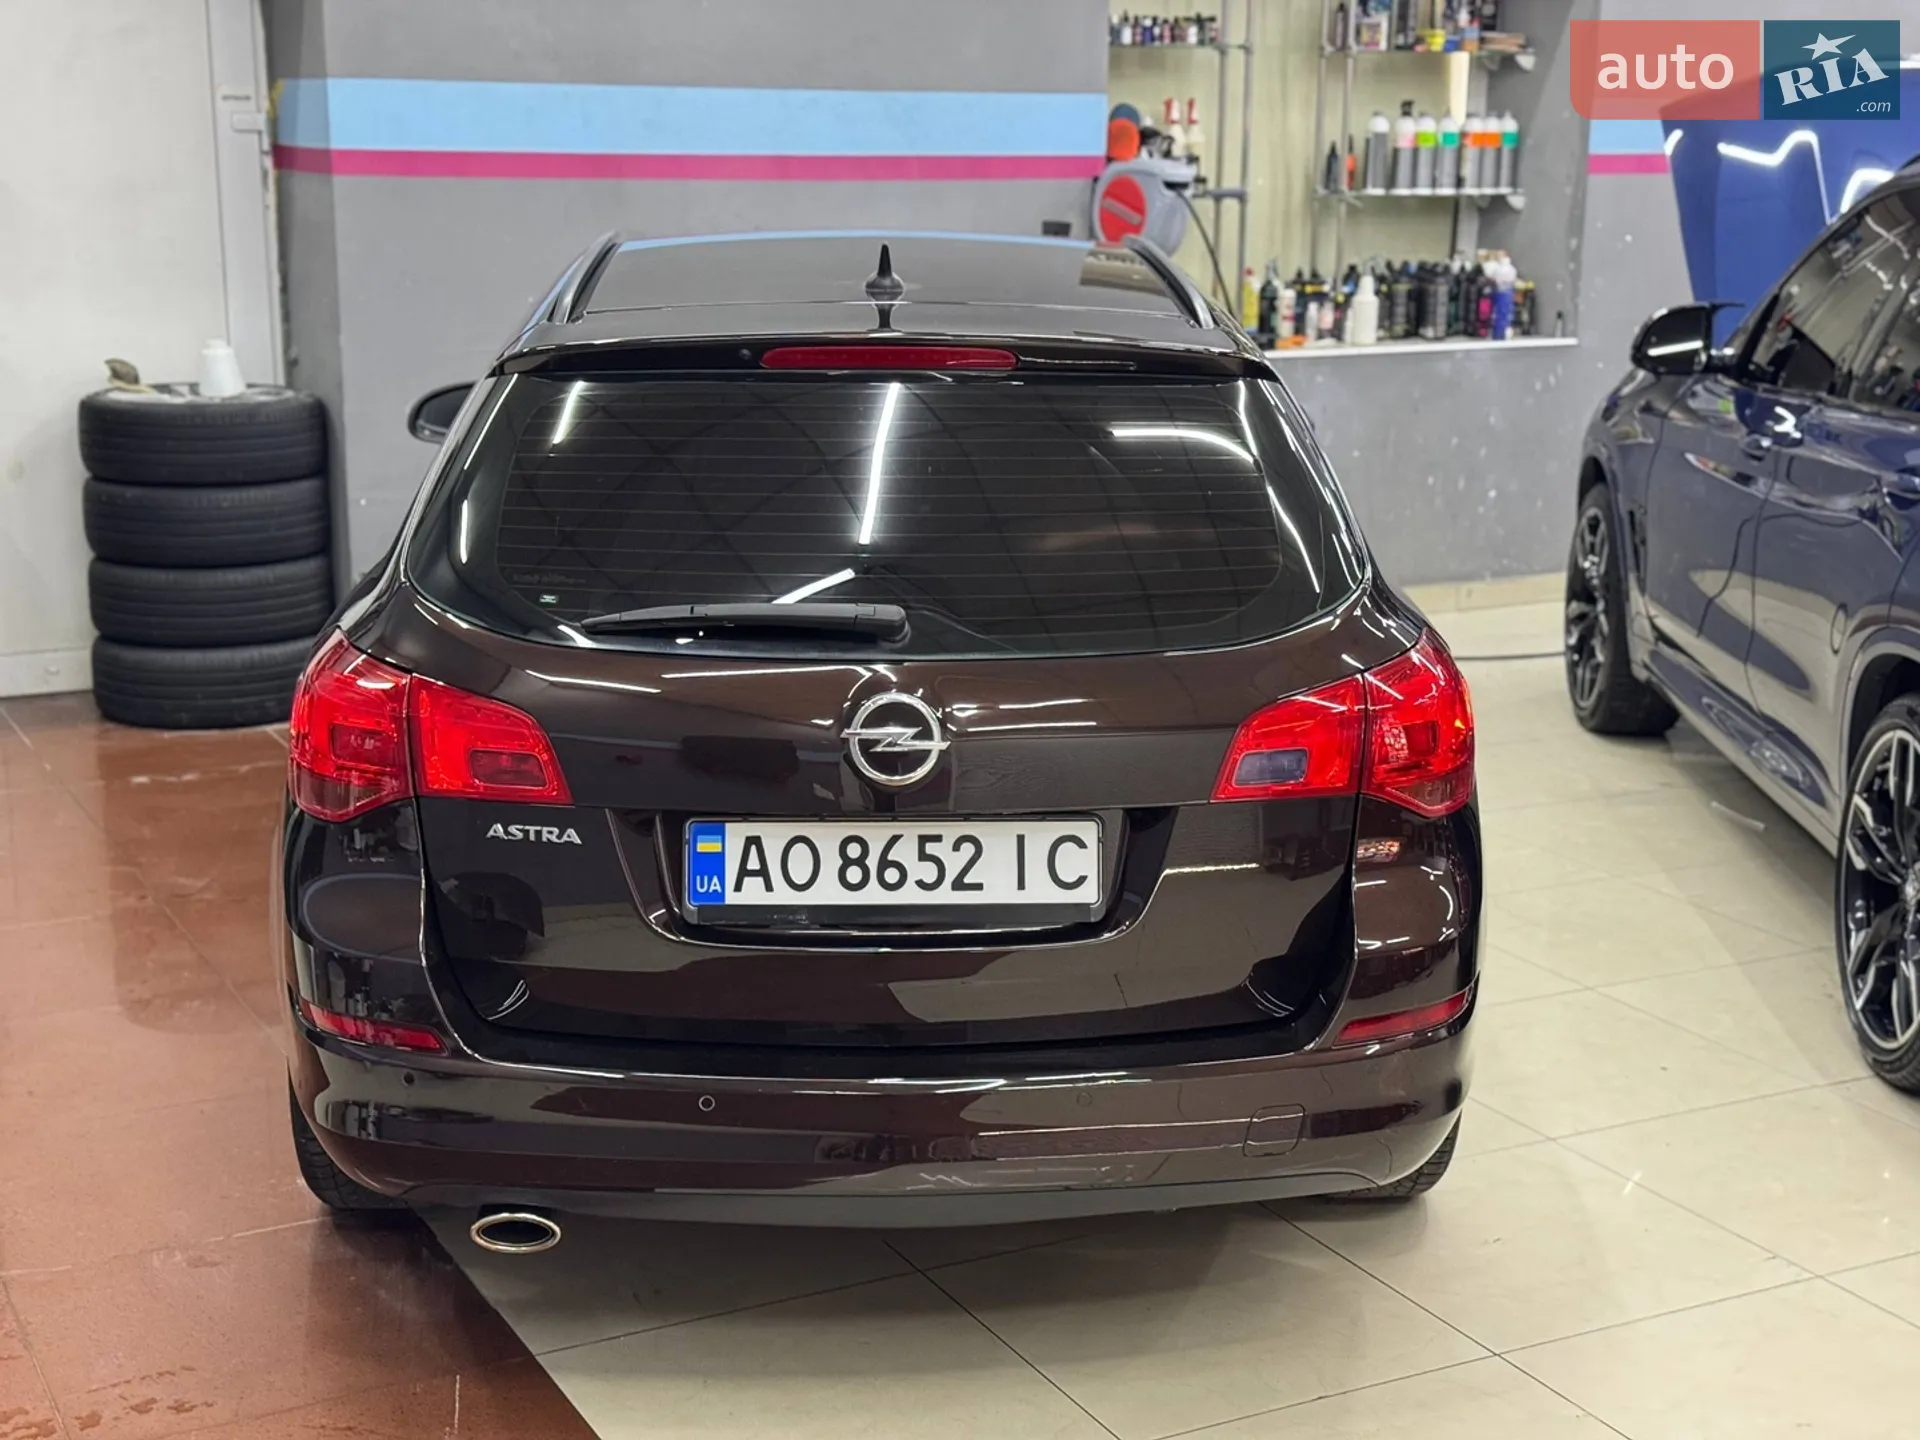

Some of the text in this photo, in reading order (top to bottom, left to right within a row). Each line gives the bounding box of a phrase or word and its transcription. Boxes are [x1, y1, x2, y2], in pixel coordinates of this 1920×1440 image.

[485, 822, 582, 845] ASTRA
[733, 833, 1089, 893] AO 8652 IC
[696, 875, 722, 893] UA
